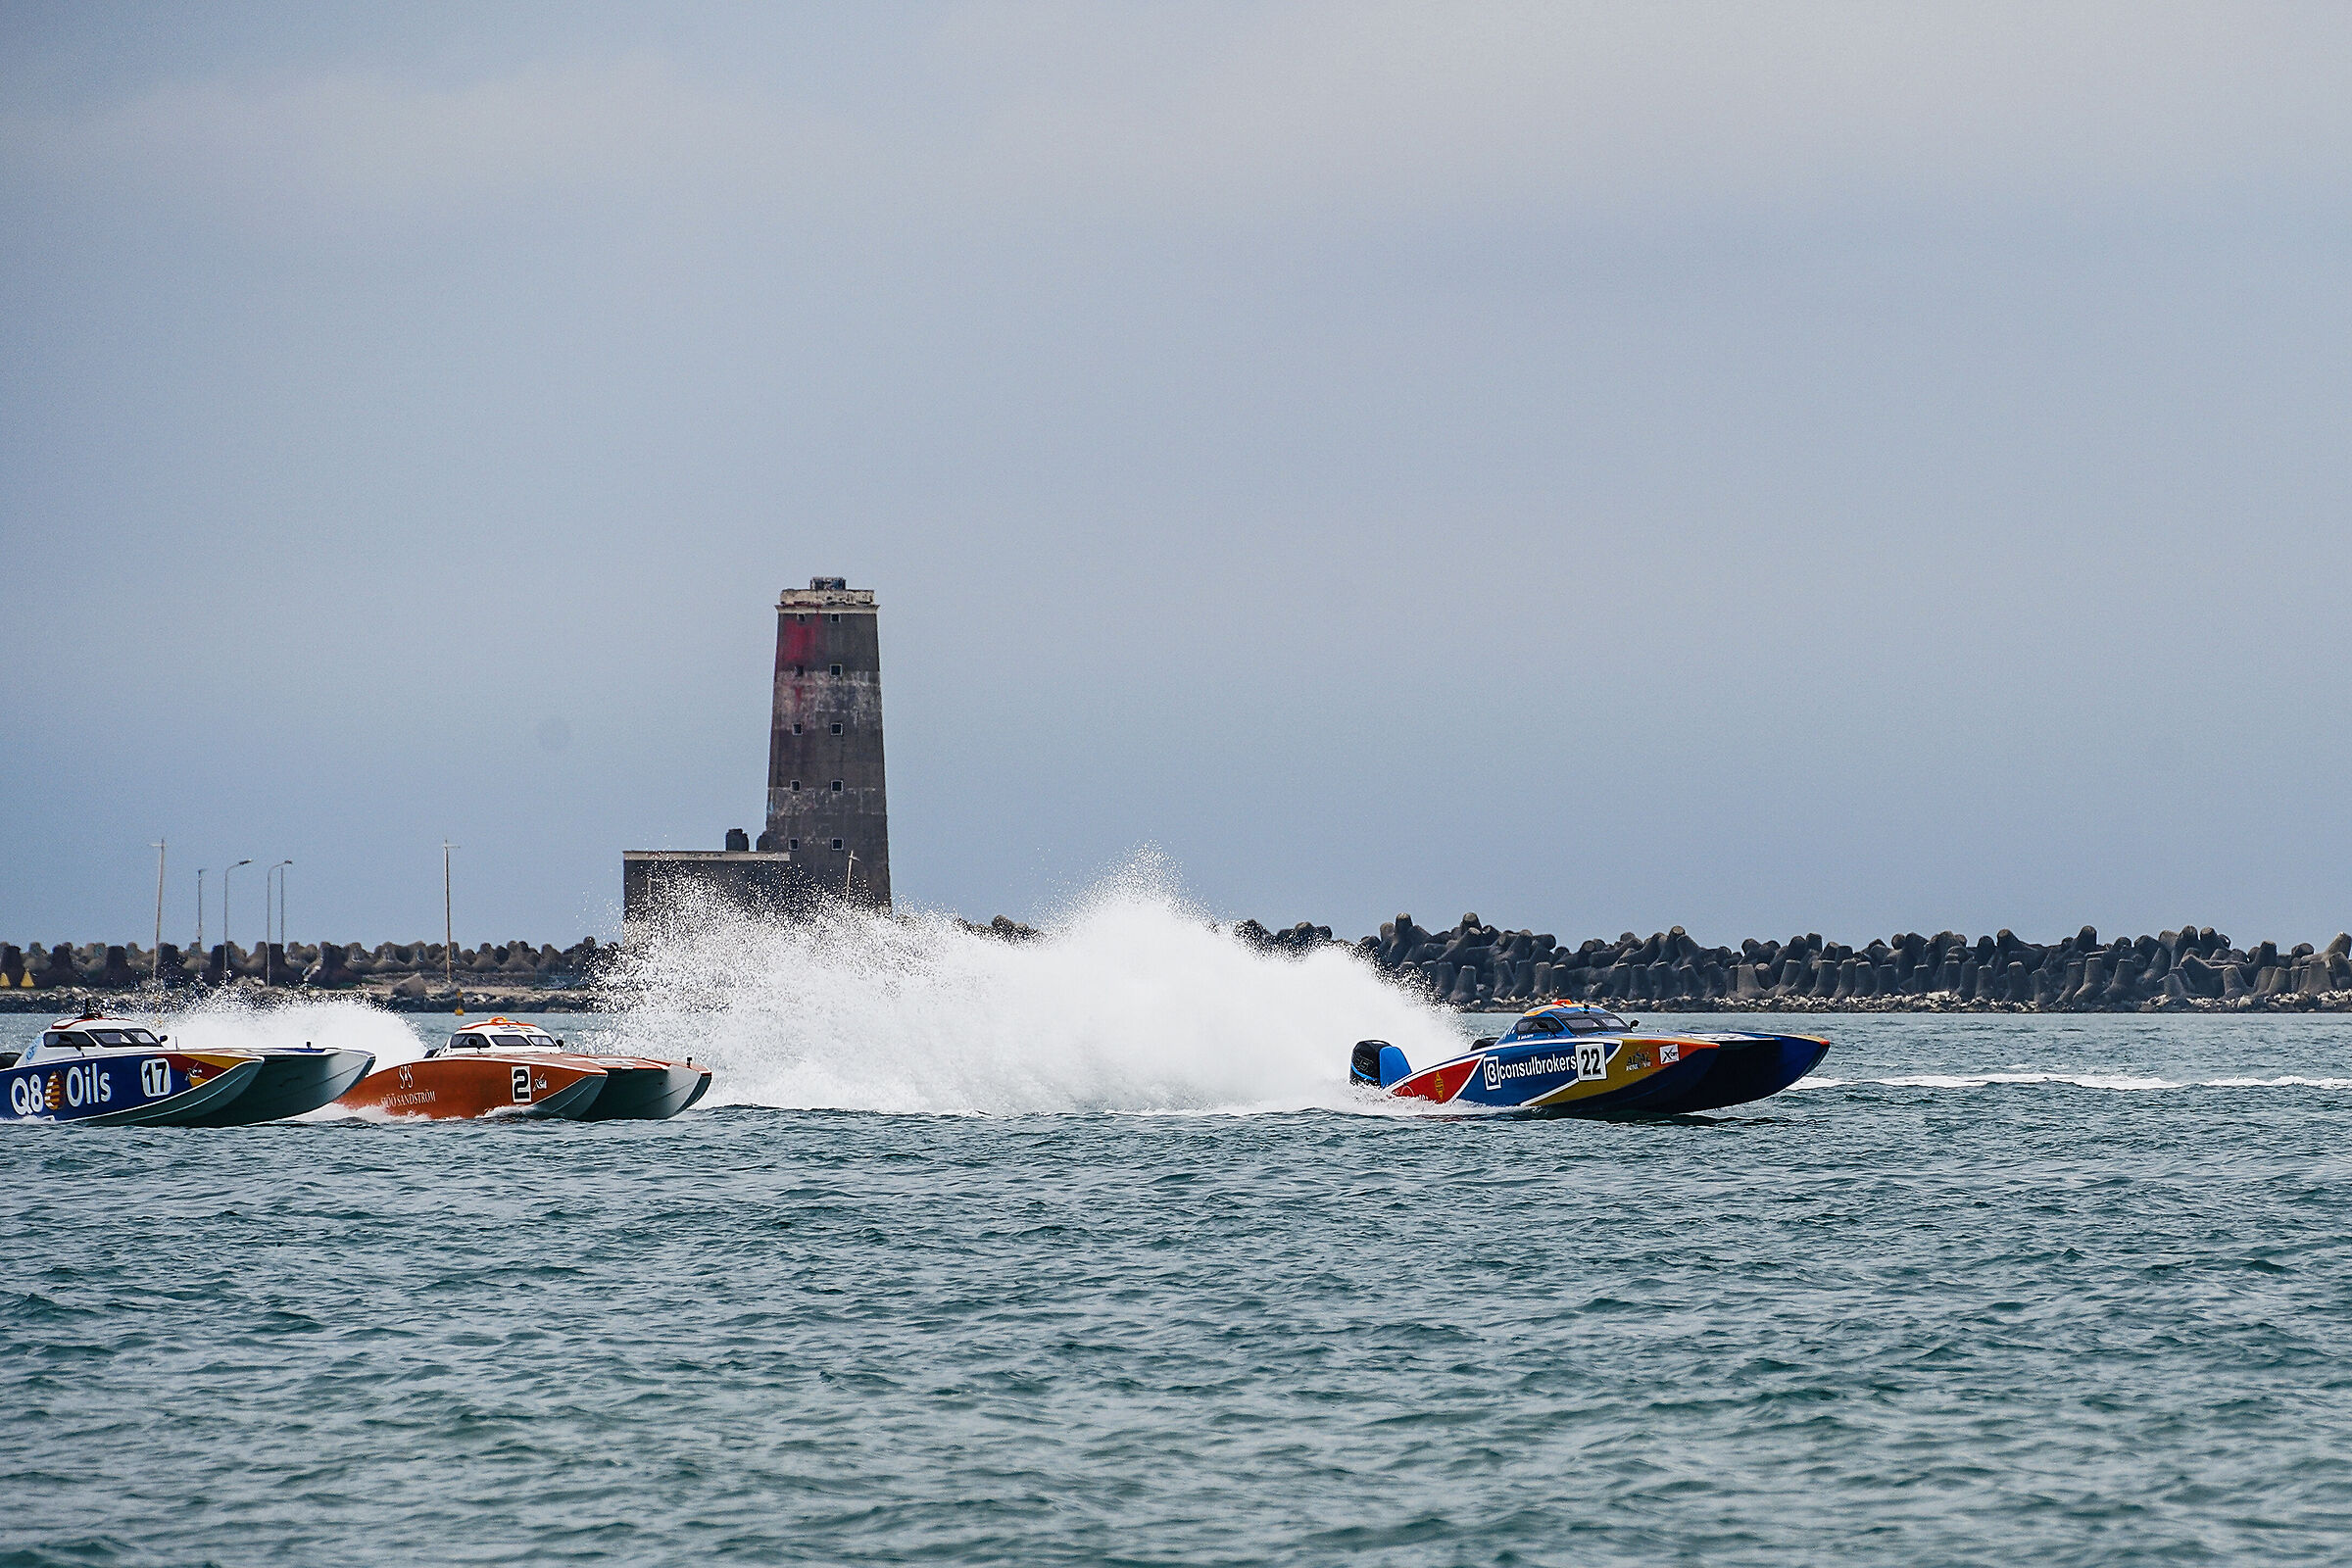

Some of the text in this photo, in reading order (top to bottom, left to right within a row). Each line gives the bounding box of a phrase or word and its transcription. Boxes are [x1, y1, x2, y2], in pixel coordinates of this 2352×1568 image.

[1499, 1054, 1577, 1080] consulbrokers
[1581, 1049, 1601, 1076] 22
[11, 1062, 111, 1115] Q8 Oils
[144, 1060, 167, 1095] 17
[513, 1069, 530, 1100] 2
[397, 1089, 436, 1106] SANDSTRÖM
